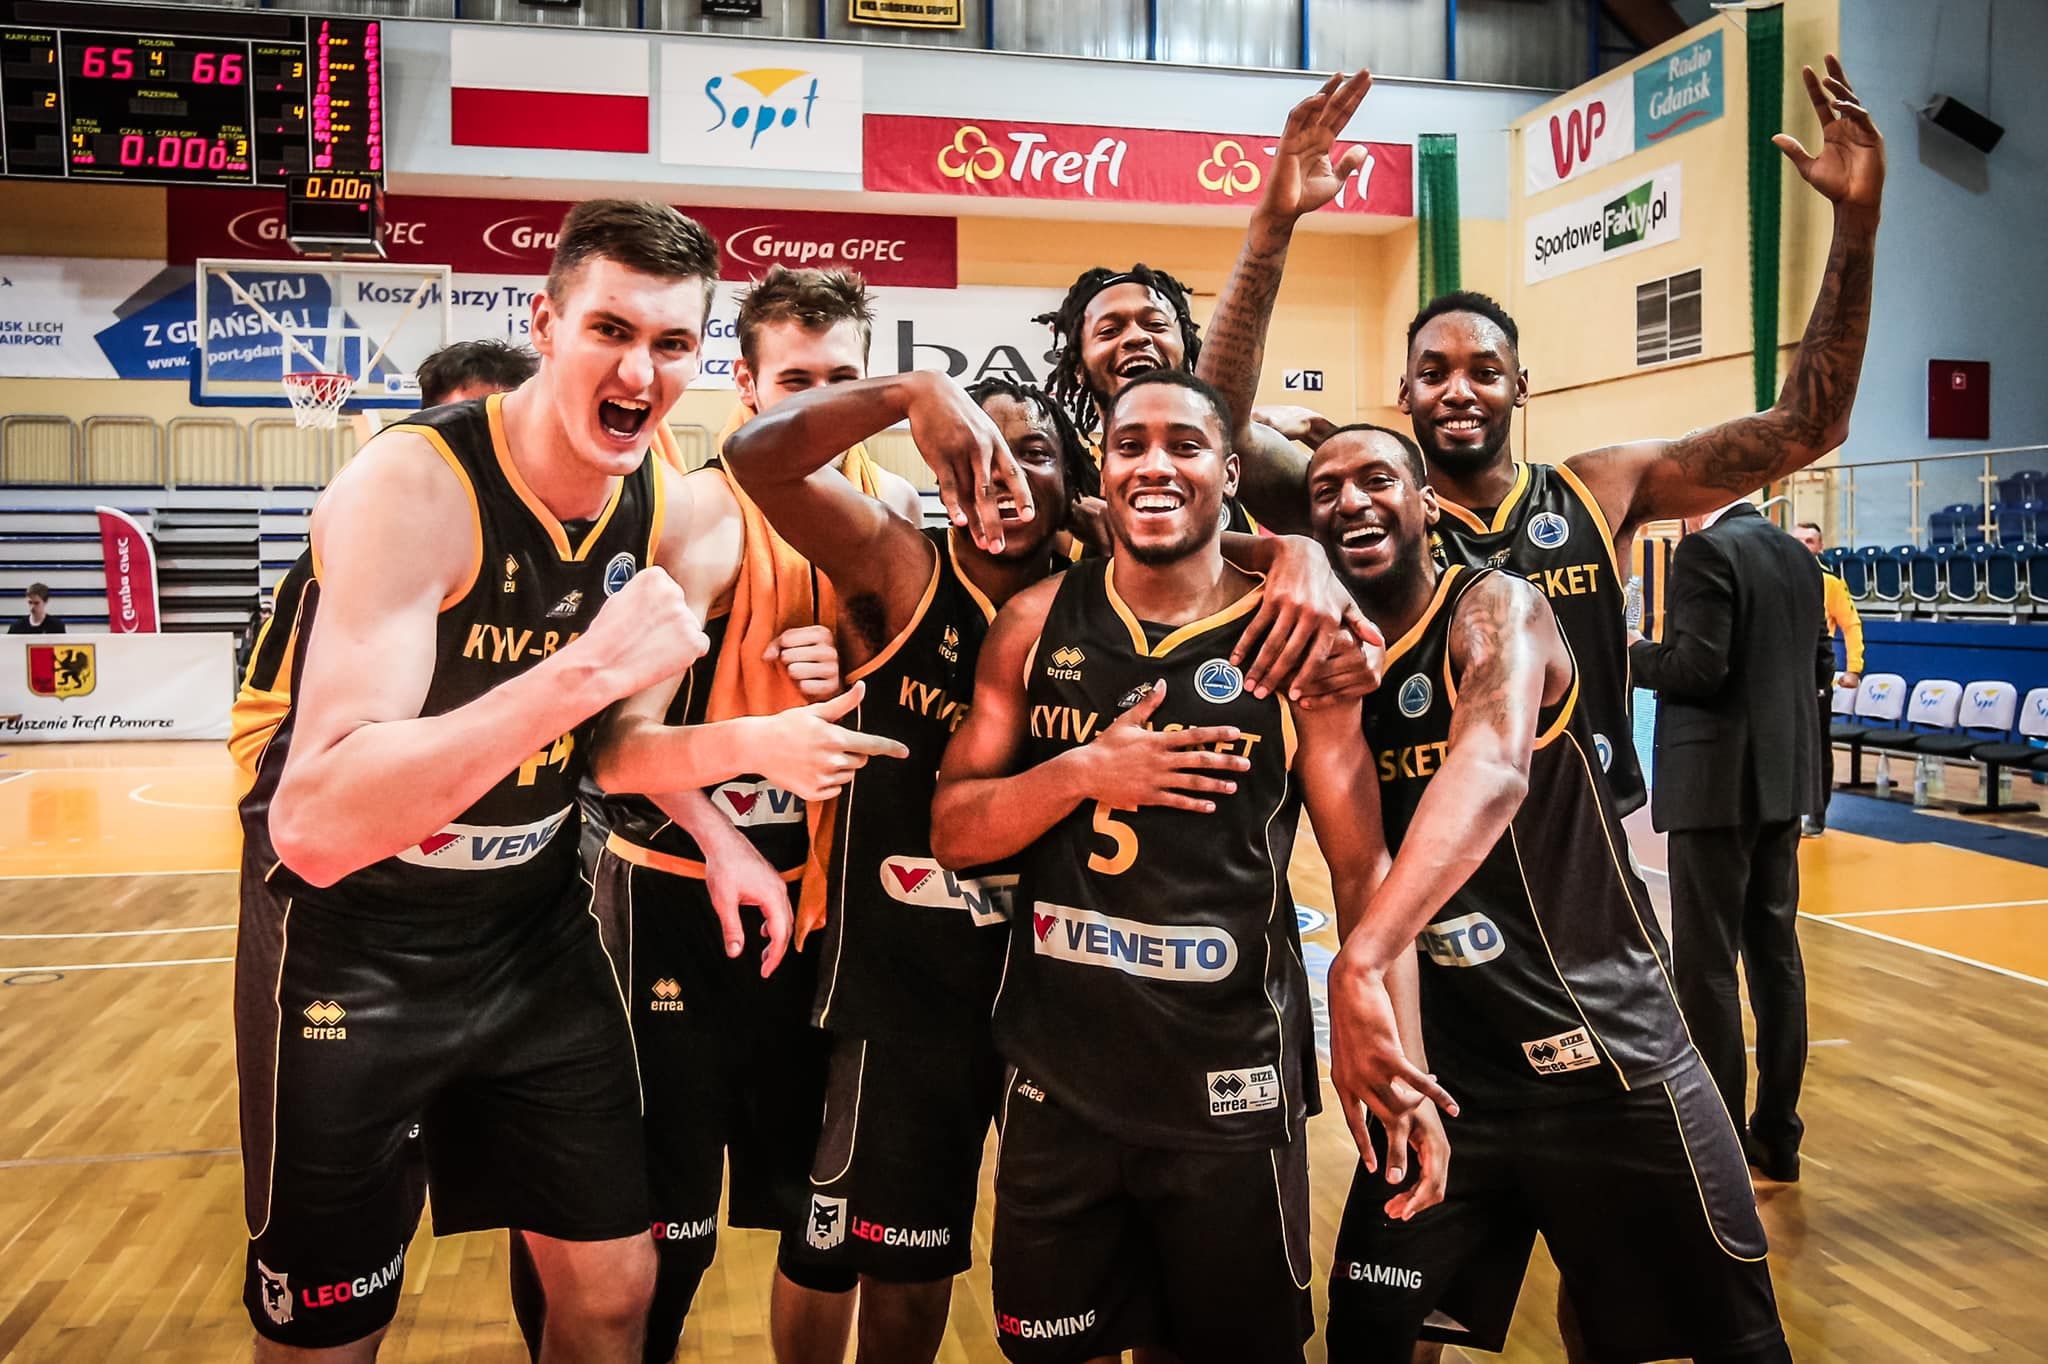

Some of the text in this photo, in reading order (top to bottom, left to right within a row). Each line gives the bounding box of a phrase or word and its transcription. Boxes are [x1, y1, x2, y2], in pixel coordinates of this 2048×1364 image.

[82, 46, 135, 79] 65
[150, 51, 163, 66] 4
[1668, 45, 1711, 82] Radio
[192, 53, 244, 85] 66
[291, 62, 303, 78] 3
[44, 92, 57, 108] 2
[1649, 72, 1711, 120] Gdańsk
[293, 104, 305, 120] 4
[704, 76, 819, 150] Sopot
[72, 133, 84, 148] 4
[235, 139, 248, 156] 3
[1550, 101, 1606, 179] WP
[1007, 132, 1127, 196] Trefl
[752, 235, 906, 263] Grupa GPEC
[232, 279, 307, 305] LATAJ
[28, 322, 63, 333] LECH
[143, 325, 162, 347] Z
[1047, 666, 1082, 681] errea
[72, 714, 106, 732] Trefl
[109, 715, 174, 729] Pomorze
[1087, 803, 1139, 875] 5
[1065, 918, 1228, 970] VENETO
[650, 998, 684, 1012] errea
[302, 1025, 347, 1041] errea
[1559, 1033, 1584, 1048] SIZE
[1250, 1070, 1274, 1083] SIZE
[1259, 1086, 1268, 1098] L
[1212, 1098, 1248, 1113] errea
